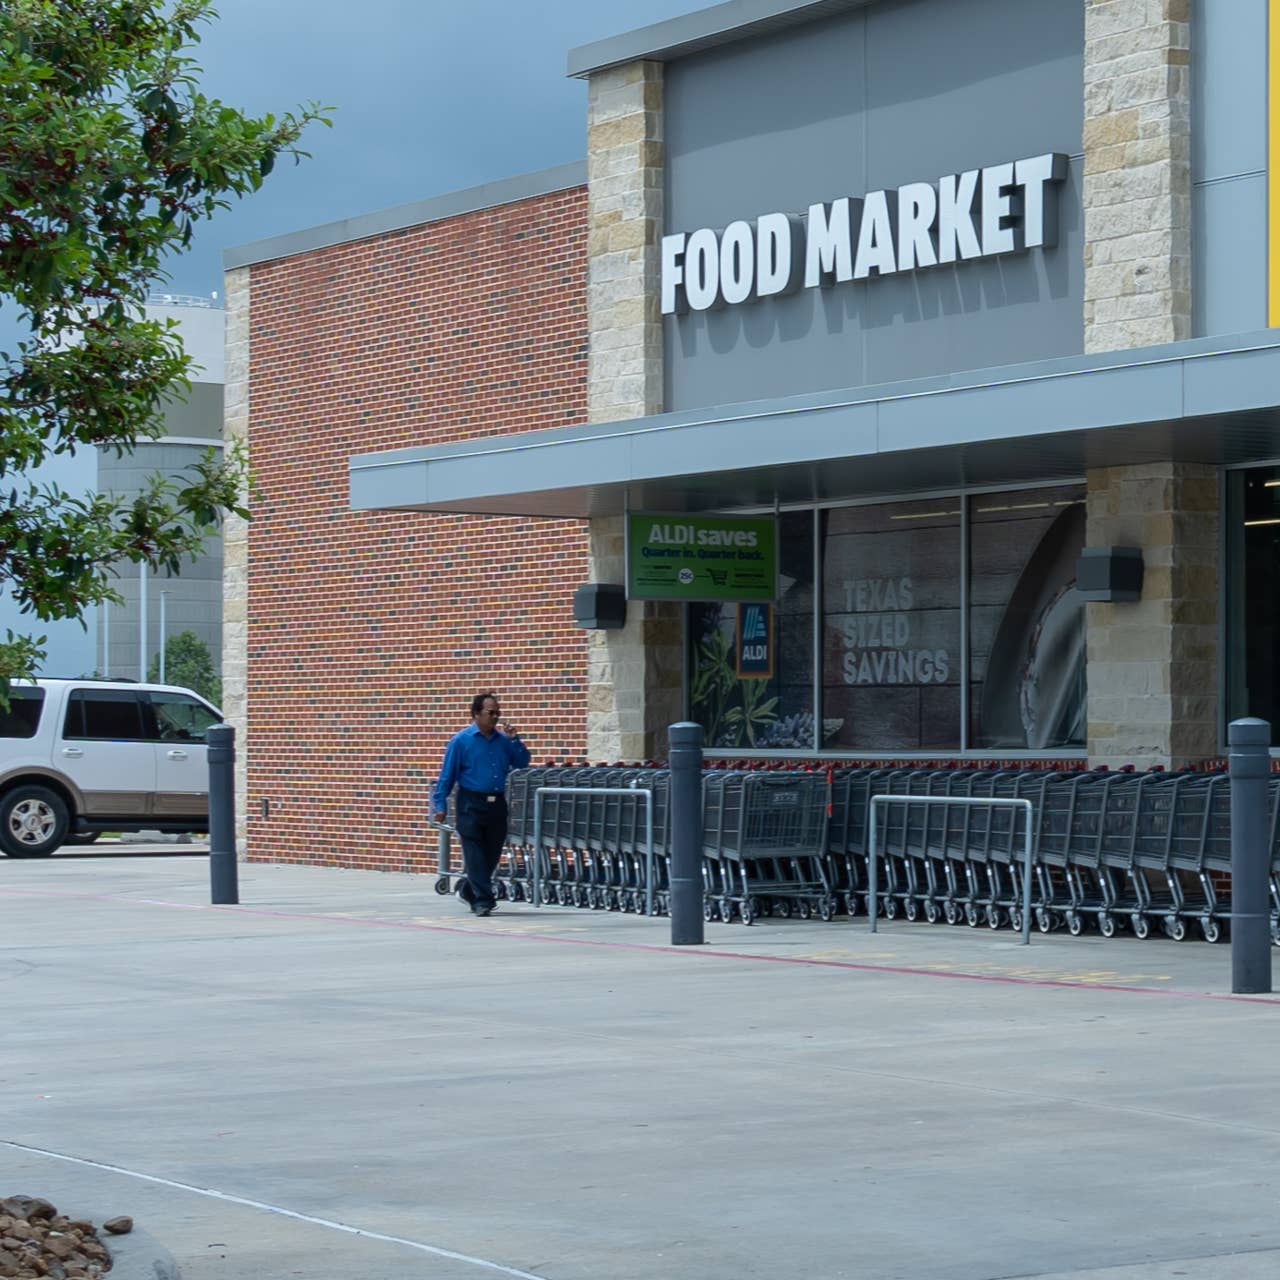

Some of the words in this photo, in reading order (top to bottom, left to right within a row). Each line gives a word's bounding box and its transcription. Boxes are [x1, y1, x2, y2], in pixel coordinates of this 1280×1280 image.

[660, 212, 792, 315] FOOD
[804, 152, 1055, 289] MARKET
[648, 524, 695, 545] ALDI
[697, 528, 758, 547] saves
[843, 577, 913, 612] TEXAS
[843, 614, 910, 648] SIZED
[742, 645, 768, 661] ALDI
[843, 649, 949, 684] SAVINGS
